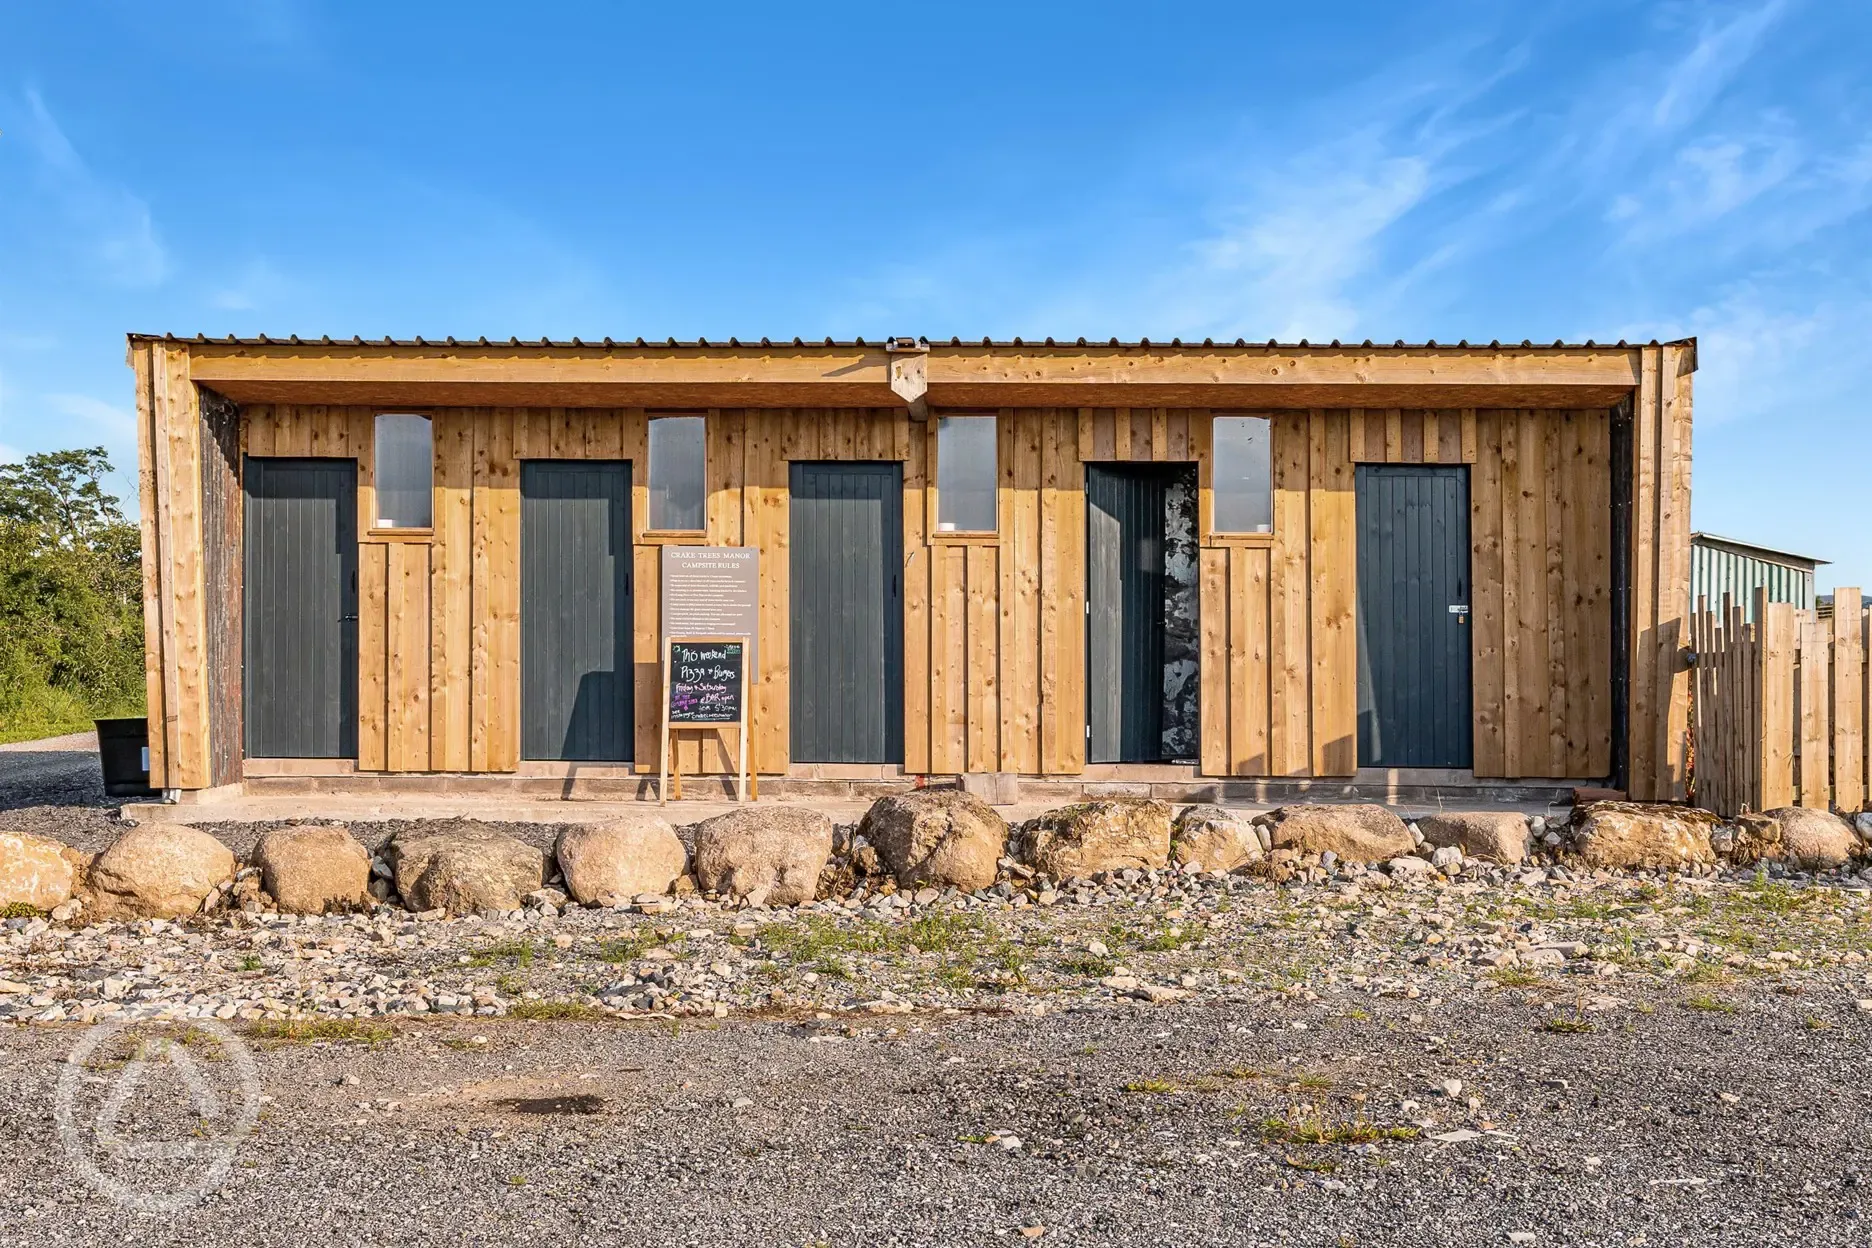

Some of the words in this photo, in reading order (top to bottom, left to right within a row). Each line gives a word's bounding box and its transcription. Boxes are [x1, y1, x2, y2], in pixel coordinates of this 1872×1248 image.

[680, 665, 705, 683] Pizza
[675, 682, 693, 694] Friday
[699, 682, 727, 694] Saturday
